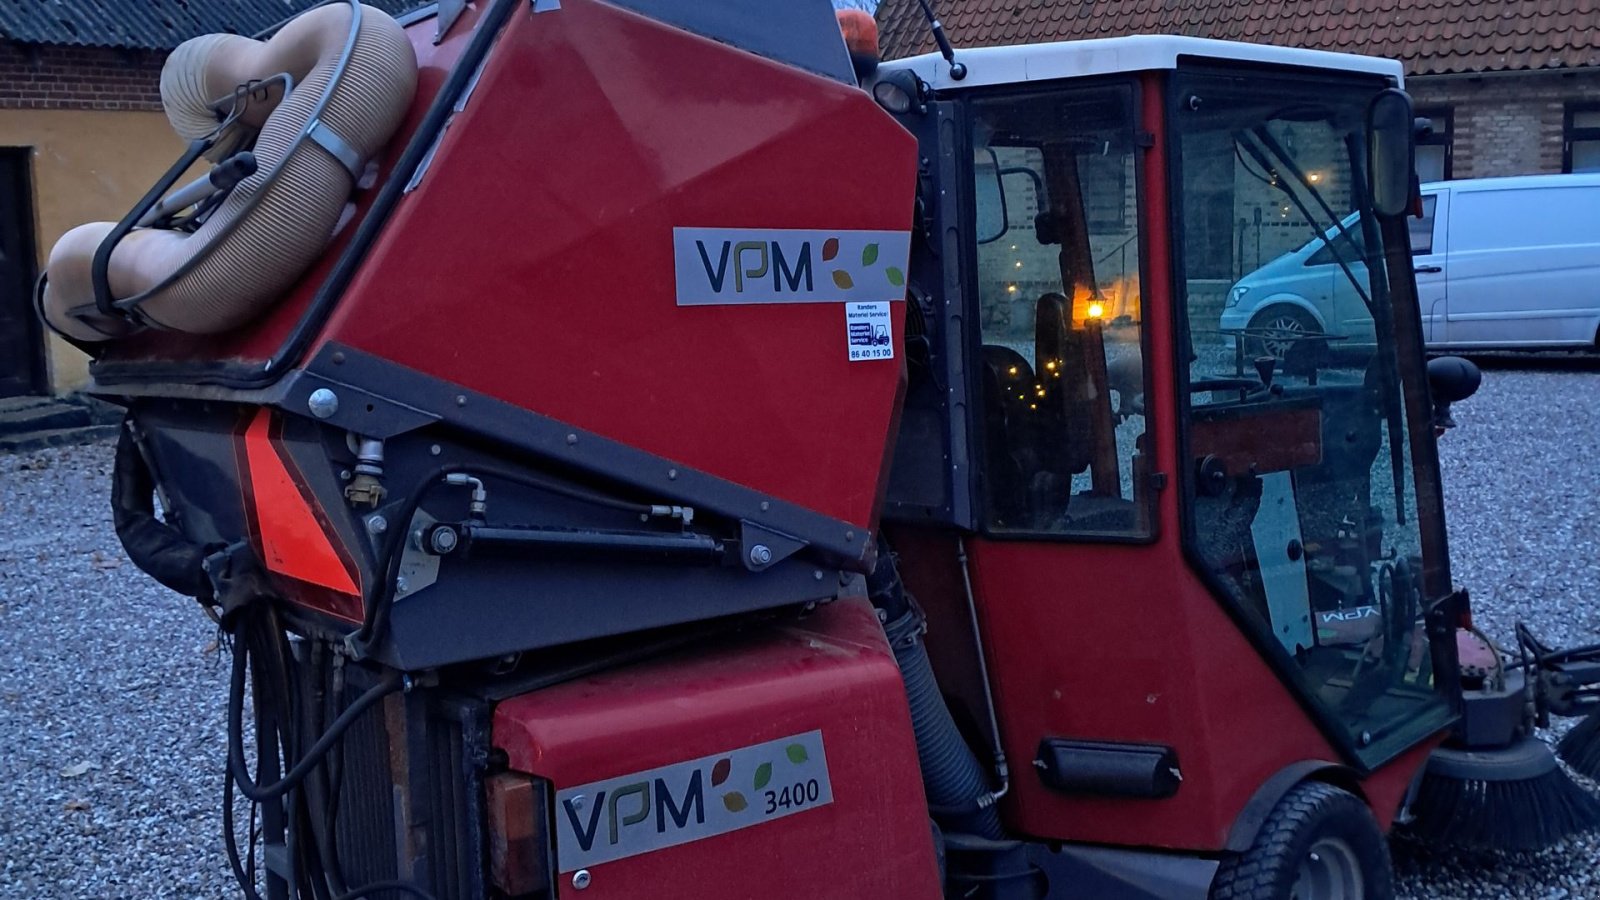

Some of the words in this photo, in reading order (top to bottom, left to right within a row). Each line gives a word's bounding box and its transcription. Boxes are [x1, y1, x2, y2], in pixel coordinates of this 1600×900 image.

[696, 240, 813, 292] VPM
[851, 350, 860, 358] 86
[873, 349, 880, 357] 15
[563, 769, 705, 851] VPM
[765, 778, 819, 814] 3400
